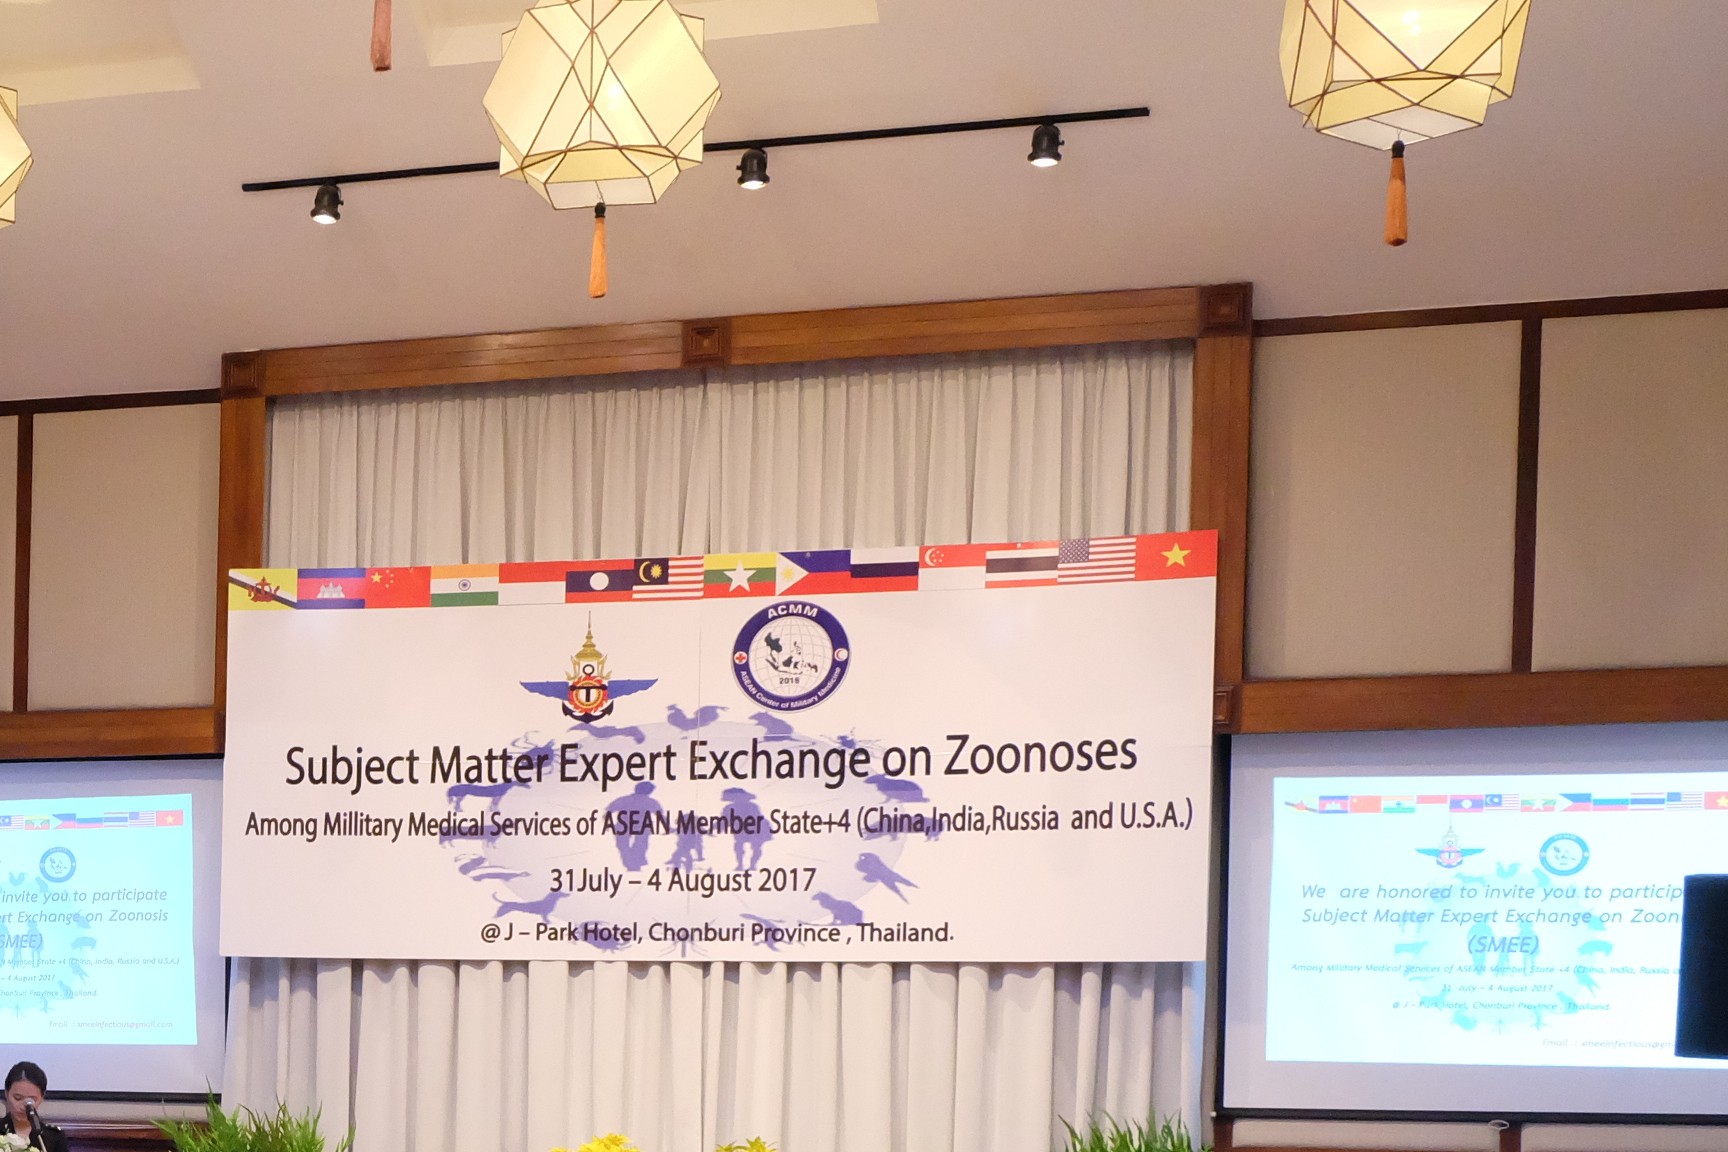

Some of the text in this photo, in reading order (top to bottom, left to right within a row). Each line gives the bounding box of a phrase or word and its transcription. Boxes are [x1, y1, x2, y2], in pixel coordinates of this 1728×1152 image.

[767, 604, 818, 619] ACMM
[740, 666, 842, 709] ASEAN Center of Military Medicine
[285, 734, 1139, 796] Subject Matter Expert Exchange on Zoonoses
[245, 811, 318, 843] Among
[323, 810, 403, 843] Millitary
[408, 810, 485, 837] Medical
[490, 810, 571, 837] Services
[576, 808, 598, 837] of
[601, 810, 671, 837] ASEAN
[676, 809, 765, 836] Member
[769, 808, 852, 836] State+4
[1071, 800, 1114, 830] and
[1119, 797, 1194, 831] U.S.A.)
[646, 868, 663, 892] 4
[667, 867, 752, 899] August
[758, 867, 817, 893] 2017
[1302, 883, 1684, 902] We are honored to invite you to particip
[1, 890, 38, 904] invite
[42, 891, 69, 905] you
[73, 890, 88, 903] to
[92, 888, 168, 905] participate
[17, 910, 81, 926] Exchange
[86, 911, 103, 923] on
[108, 908, 169, 923] Zoonosis
[1301, 907, 1368, 926] Subject
[1373, 908, 1435, 924] Matter
[1440, 908, 1498, 926] Expert
[1505, 907, 1593, 926] Exchange
[1599, 911, 1622, 923] on
[536, 922, 579, 942] Park
[583, 921, 643, 945] Hotel,
[648, 921, 745, 943] Chonburi
[750, 922, 842, 943] Province
[856, 921, 954, 943] Thailand.
[1468, 933, 1540, 955] (SMEE)
